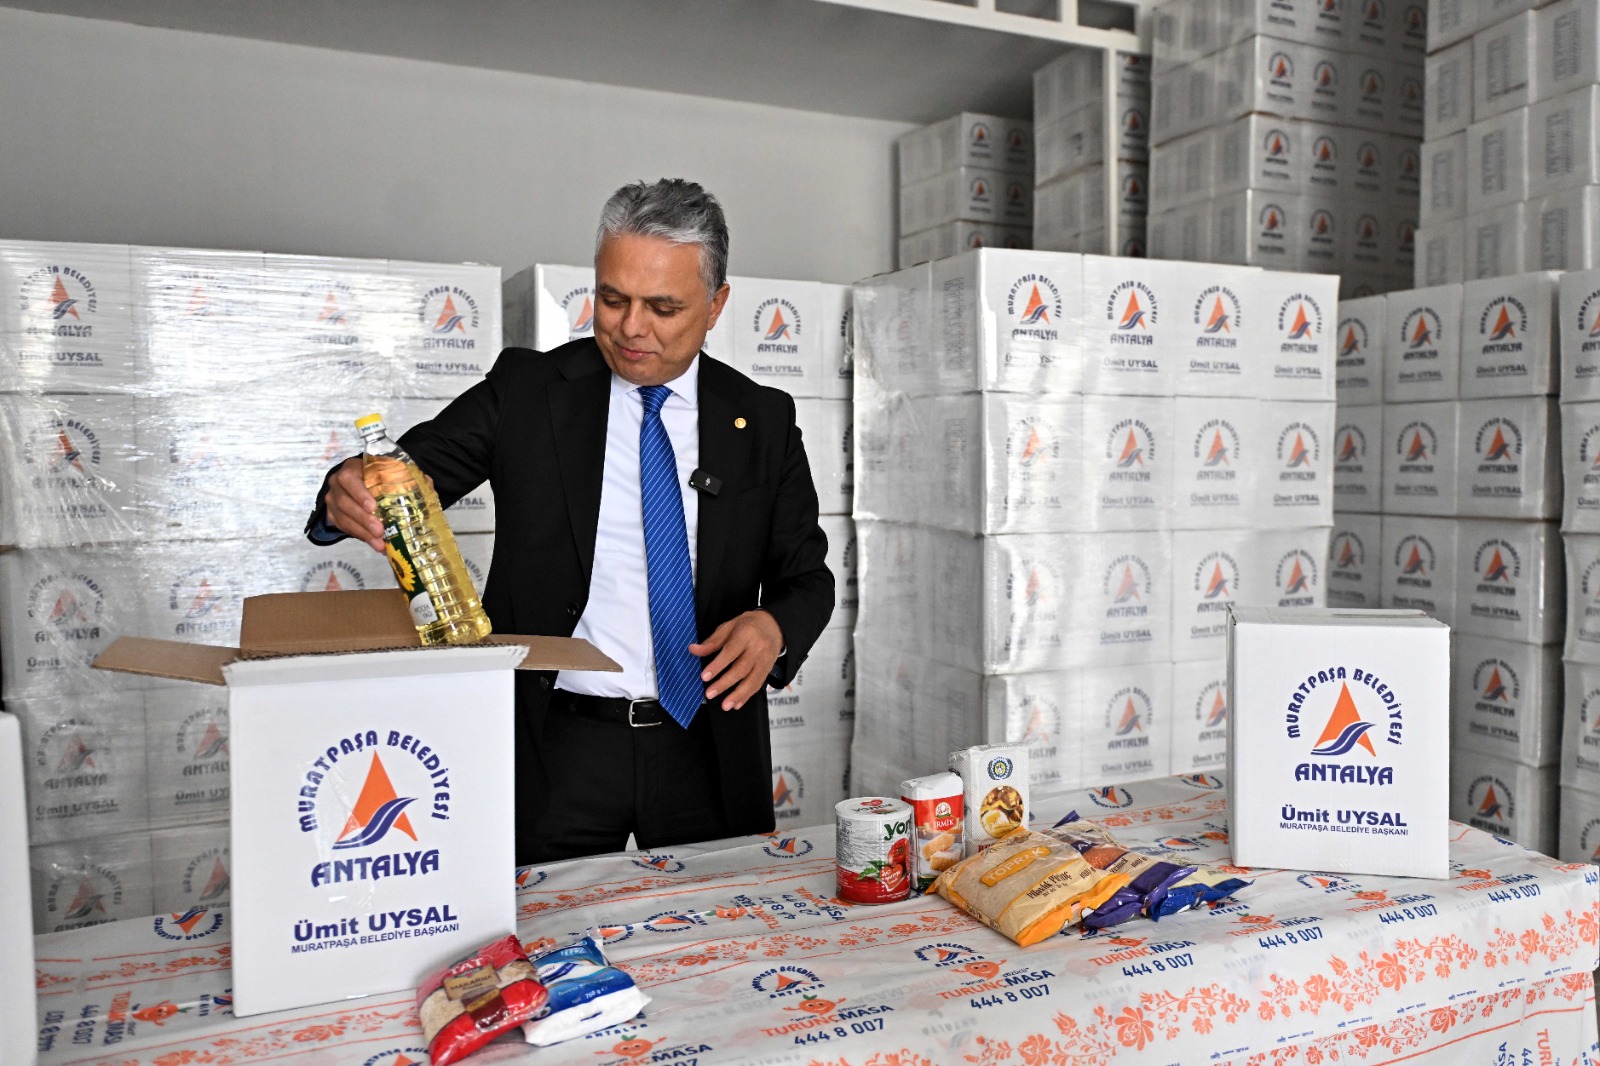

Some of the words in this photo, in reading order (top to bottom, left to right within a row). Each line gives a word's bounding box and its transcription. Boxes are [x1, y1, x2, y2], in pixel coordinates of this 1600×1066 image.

[757, 344, 798, 353] ANTALYA
[1110, 333, 1153, 345] ANTALYA
[1197, 337, 1237, 348] ANTALYA
[56, 352, 103, 361] UYSAL
[1128, 360, 1158, 368] UYSAL
[1213, 362, 1240, 370] UYSAL
[445, 363, 482, 371] UYSAL
[775, 365, 803, 373] UYSAL
[1109, 471, 1150, 482] ANTALYA
[1285, 666, 1347, 739] MURATPAŞA
[1353, 668, 1403, 745] BELEDİYESİ
[298, 730, 378, 833] MURATPAŞA
[386, 730, 450, 821] BELEDİYESİ
[1294, 763, 1393, 786] ANTALYA
[1281, 804, 1330, 823] Ümit
[1337, 810, 1407, 827] UYSAL
[1279, 822, 1328, 832] MURATPAŞA
[1331, 825, 1370, 834] BELEDİYE
[1372, 828, 1408, 836] BAŞKANI
[311, 848, 439, 887] ANTALYA
[1488, 891, 1512, 903] 444
[1510, 888, 1522, 899] 8
[1519, 883, 1541, 898] 007
[1209, 905, 1250, 916] ANTALYA
[1379, 911, 1404, 924] 444
[1403, 909, 1415, 920] 8
[1413, 904, 1438, 918] 007
[294, 918, 359, 942] Ümit
[368, 904, 457, 932] UYSAL
[291, 938, 357, 954] MURATPAŞA
[360, 930, 411, 945] BELEDİYE
[414, 923, 459, 938] BAŞKANI
[1258, 935, 1287, 949] 444
[1286, 932, 1298, 944] 8
[1297, 927, 1324, 941] 007
[935, 955, 985, 967] ANTALYA
[1088, 940, 1197, 966] TURUNÇMASA
[449, 957, 483, 975] TAT
[1122, 963, 1152, 977] 444
[1152, 960, 1166, 971] 8
[1166, 953, 1194, 969] 007
[769, 984, 825, 998] ANTALYA
[936, 969, 1056, 999] TURUNÇMASA
[970, 995, 1004, 1009] 444
[1005, 992, 1018, 1002] 8
[1020, 984, 1050, 999] 007
[585, 1023, 648, 1039] ANTALYA
[760, 1005, 894, 1037] TURUNÇMASA
[794, 1031, 830, 1045] 444
[834, 1027, 847, 1037] 8
[851, 1018, 884, 1034] 007
